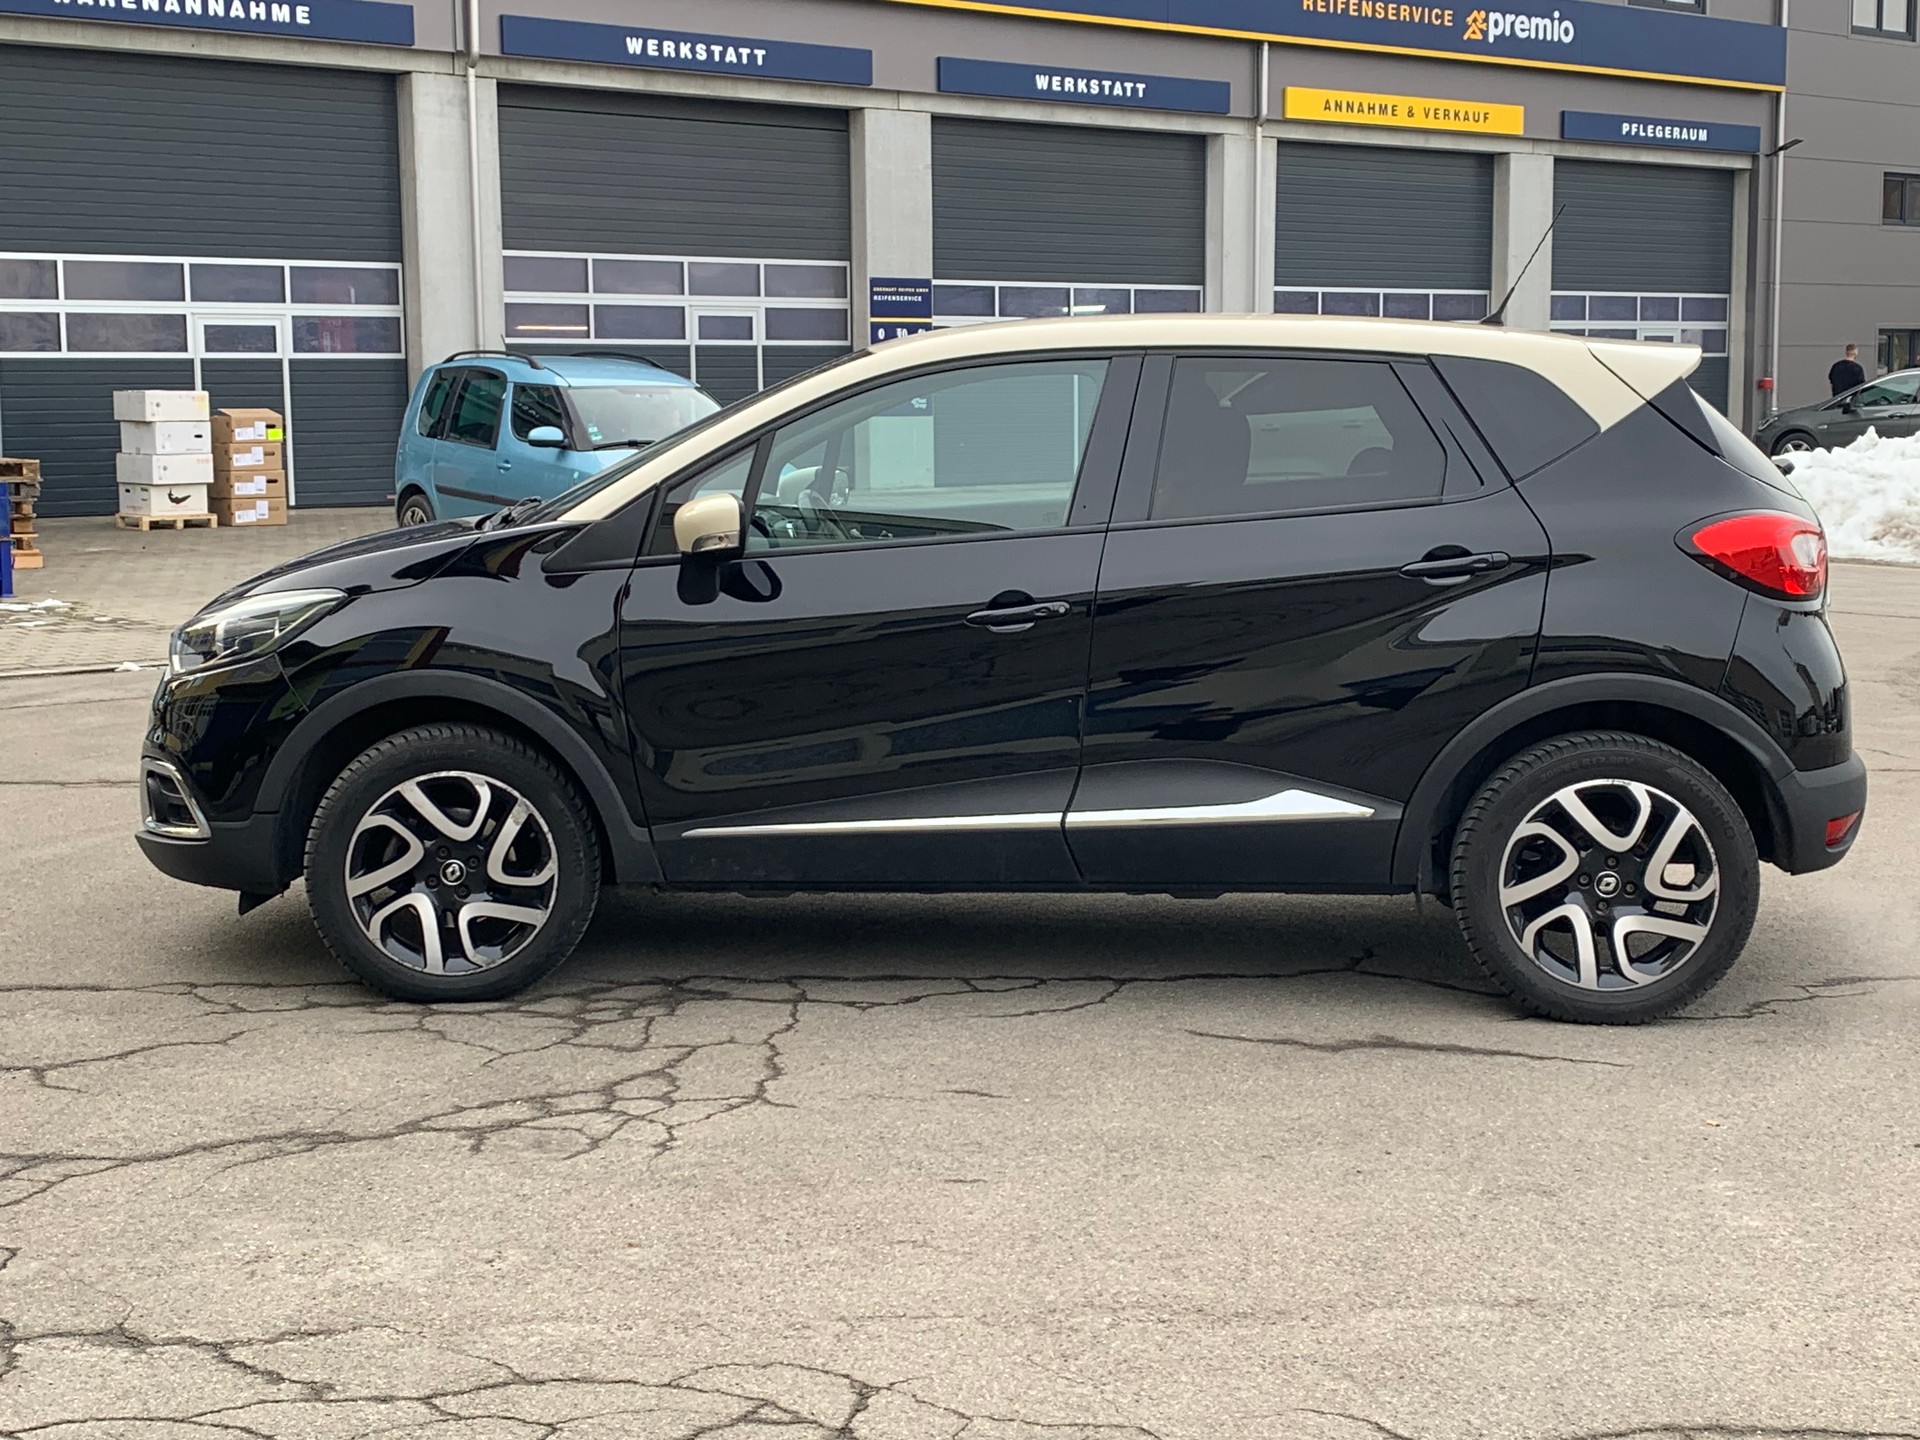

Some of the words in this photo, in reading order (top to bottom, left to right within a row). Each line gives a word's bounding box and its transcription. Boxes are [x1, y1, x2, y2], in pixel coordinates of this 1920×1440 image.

[53, 0, 311, 25] NANNAHME
[1303, 0, 1454, 27] REIFENSERVICE
[1487, 10, 1575, 44] premio
[625, 36, 767, 66] WERKSTATT
[1035, 74, 1147, 98] WERKSTATT
[1323, 98, 1399, 118] ANNAHME
[1407, 106, 1416, 119] &
[1423, 107, 1491, 125] VERKAUF
[1621, 122, 1708, 142] PFLEGERAUM
